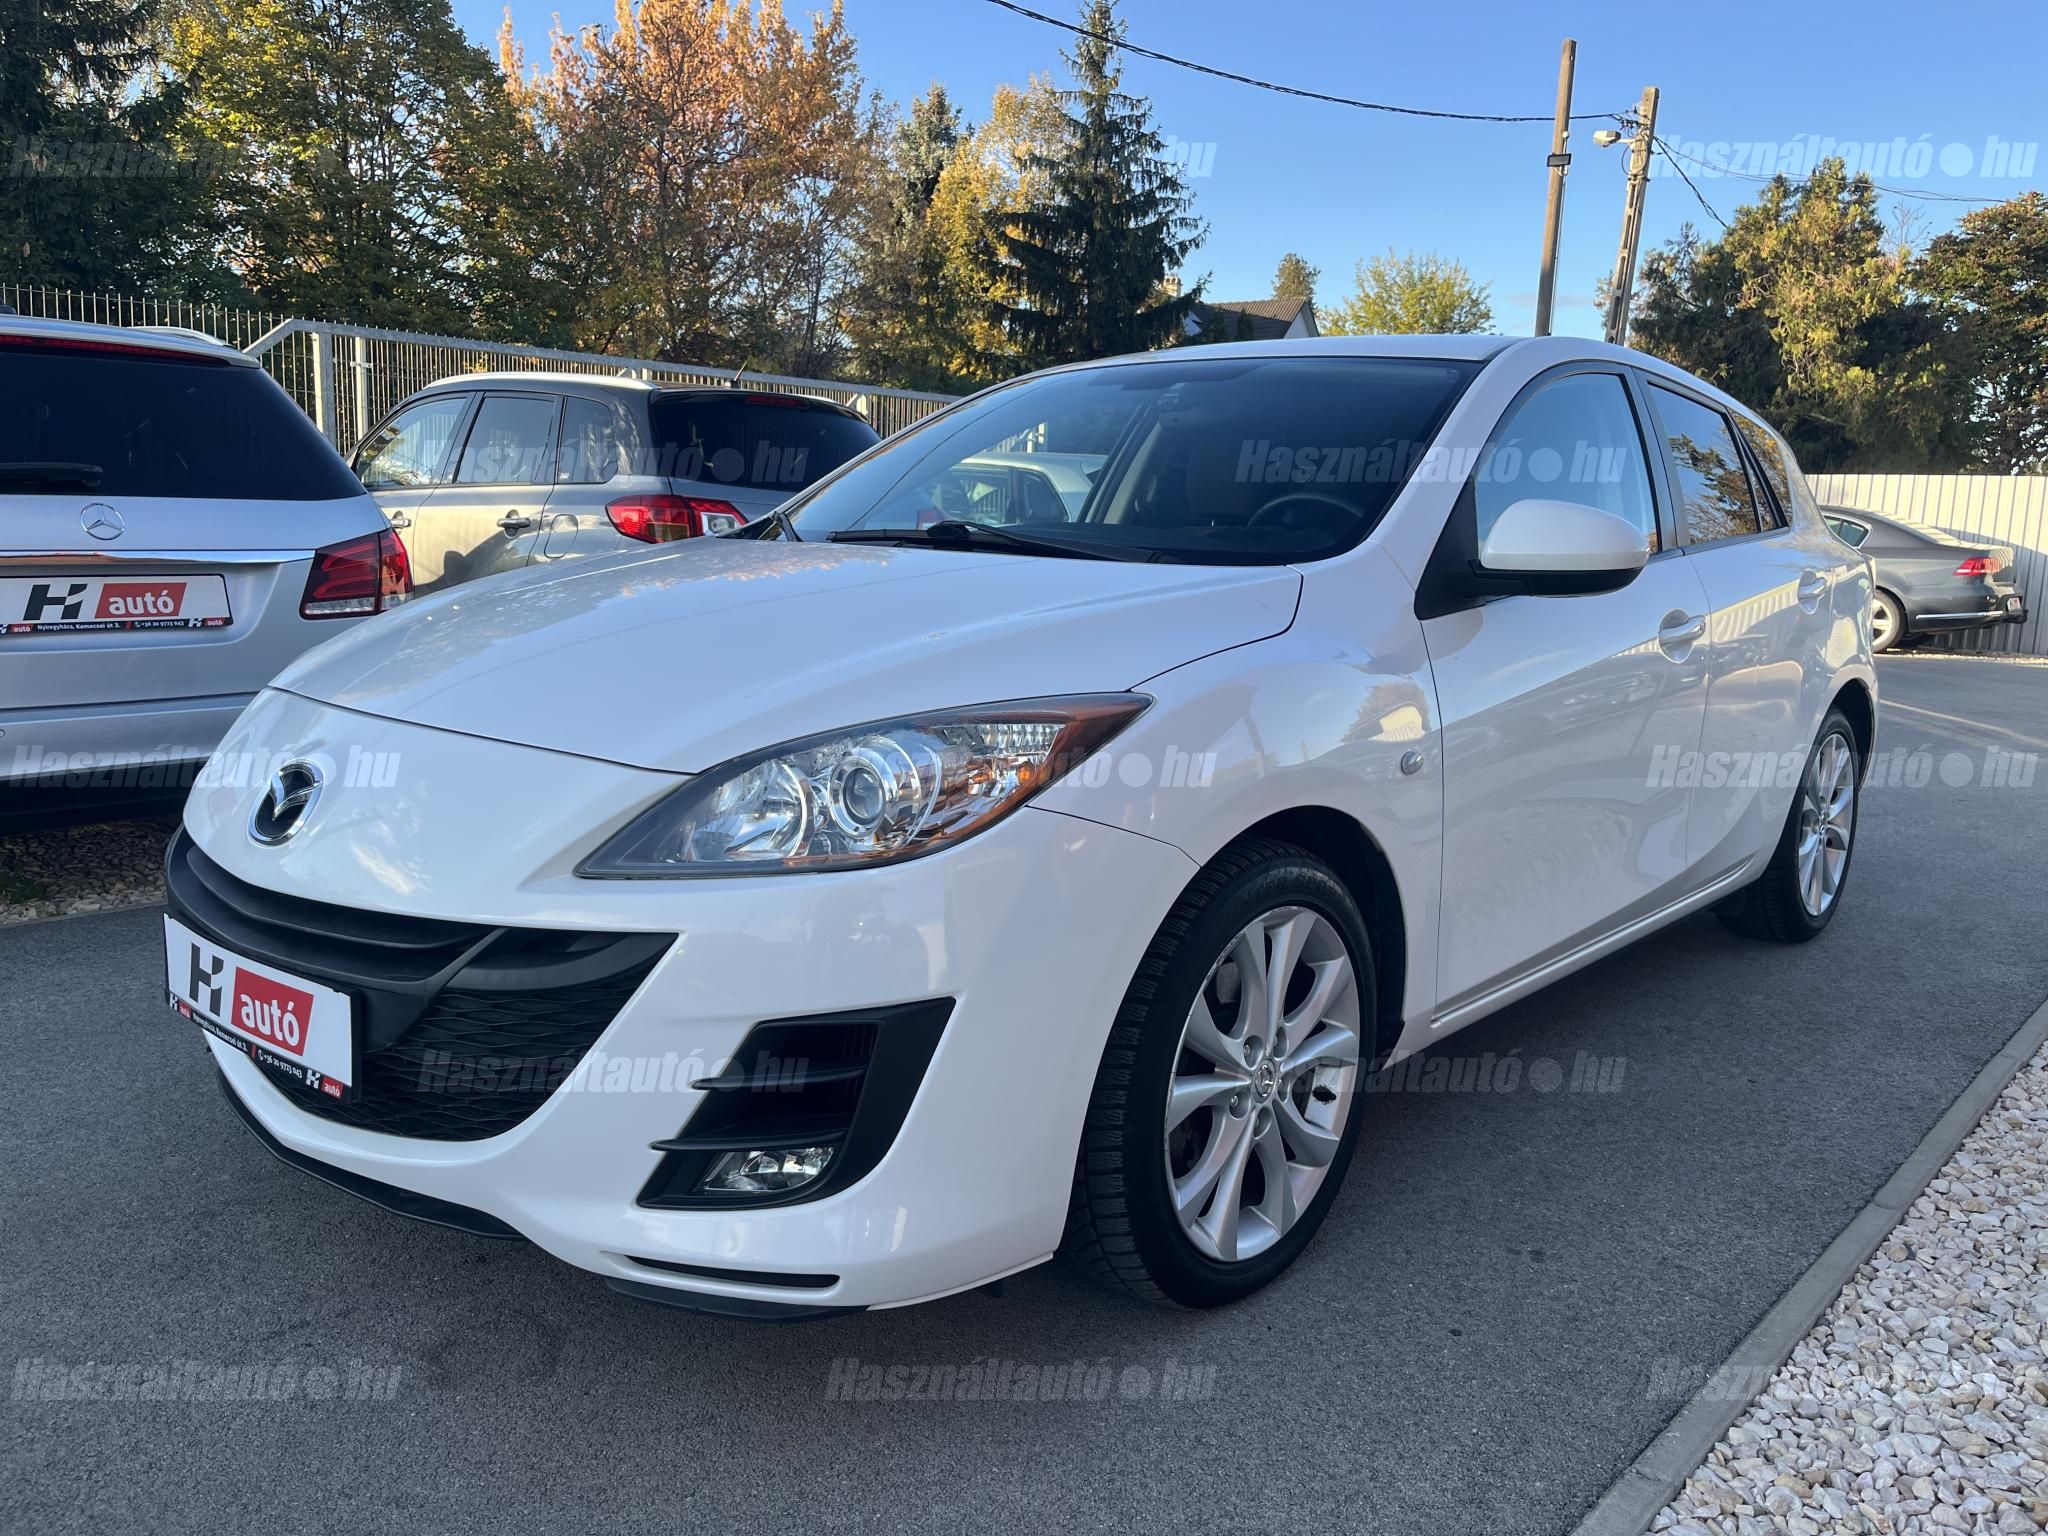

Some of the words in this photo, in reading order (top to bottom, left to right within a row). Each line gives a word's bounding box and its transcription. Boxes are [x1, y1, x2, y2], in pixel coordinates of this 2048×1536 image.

[109, 590, 175, 615] autó
[240, 993, 300, 1047] autó
[324, 1083, 341, 1098] autó
